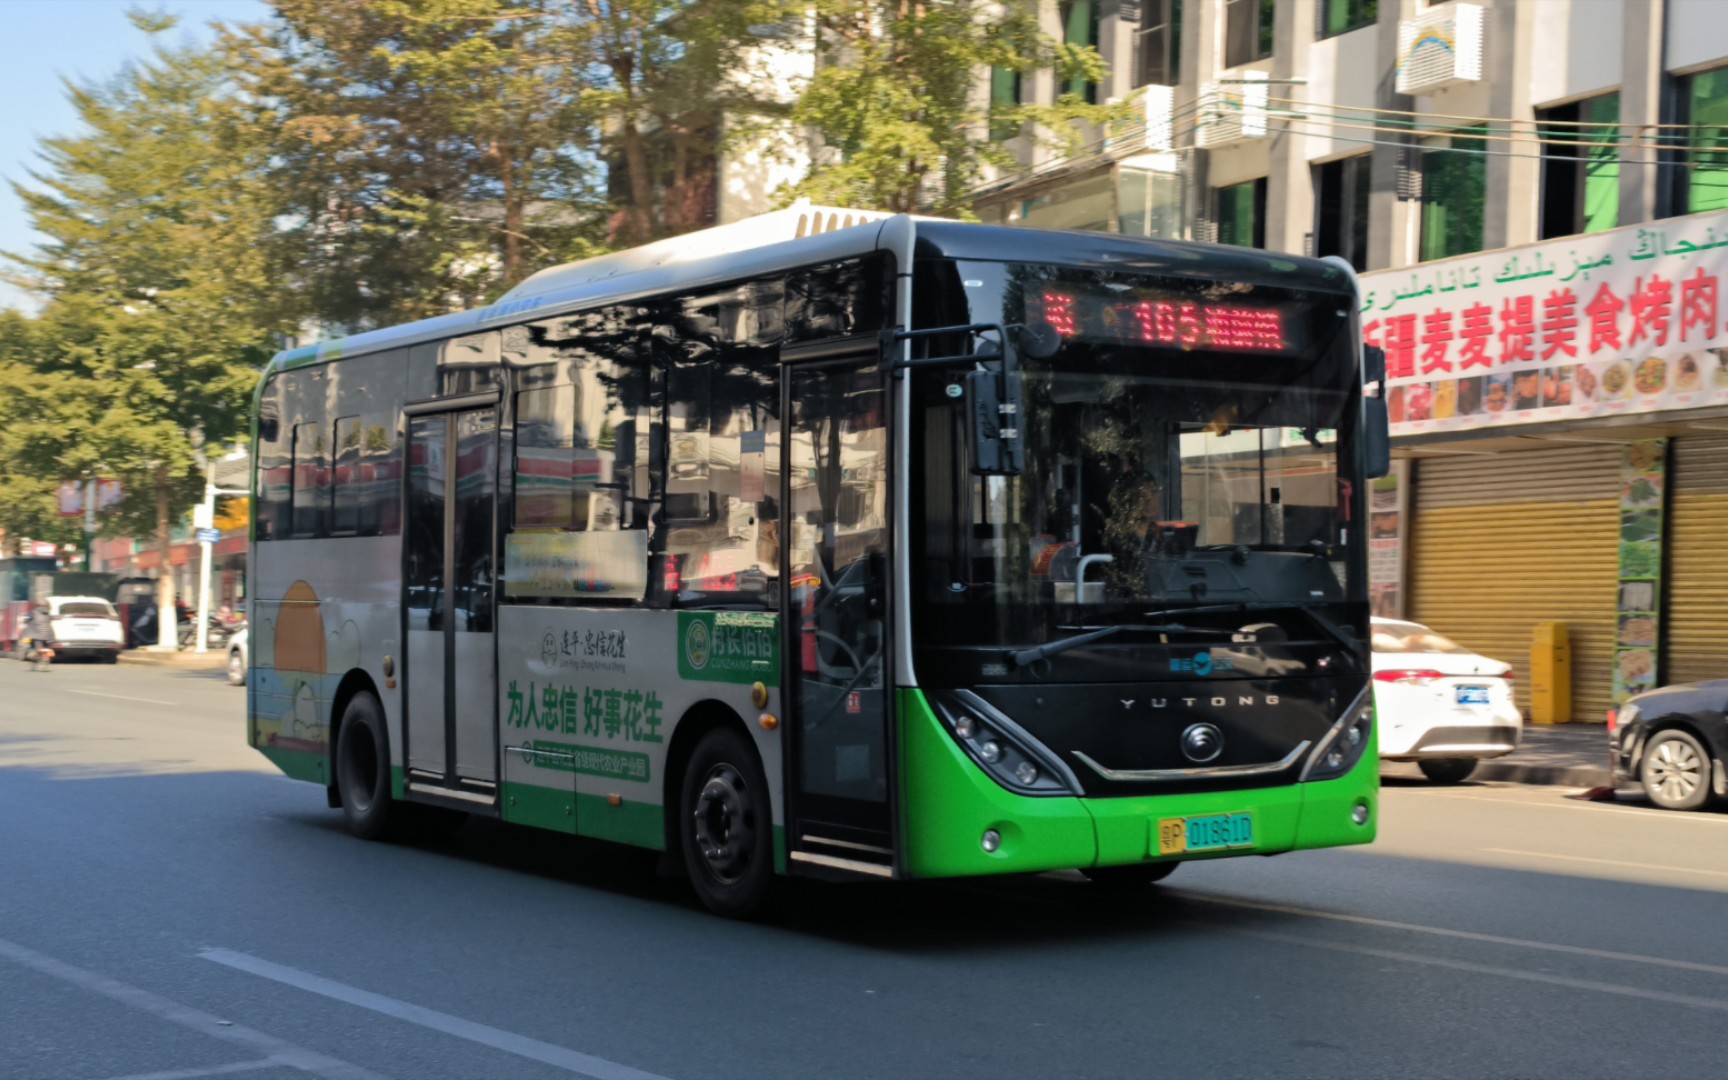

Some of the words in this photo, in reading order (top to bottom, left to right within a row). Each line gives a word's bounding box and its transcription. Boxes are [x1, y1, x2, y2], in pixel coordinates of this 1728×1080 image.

[711, 625, 772, 658] 村长伯伯
[507, 680, 578, 734] 为人忠信
[584, 686, 664, 744] 好事花生
[1120, 695, 1280, 710] YUTONG
